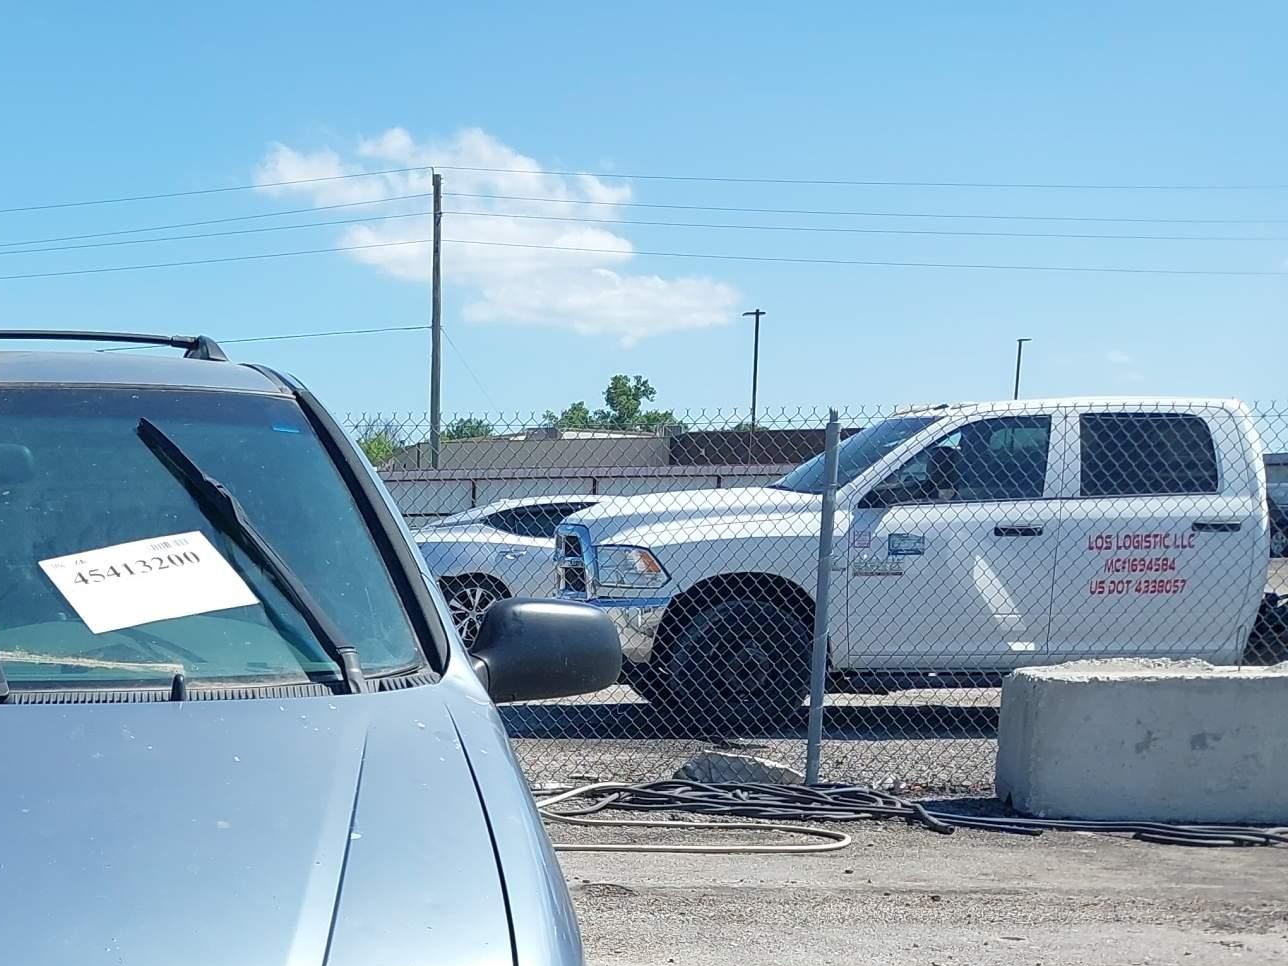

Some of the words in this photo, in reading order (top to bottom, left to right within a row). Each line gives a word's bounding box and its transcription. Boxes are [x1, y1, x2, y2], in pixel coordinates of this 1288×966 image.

[1088, 534, 1113, 551] LOS
[1116, 533, 1170, 550] LOGISTIC
[1174, 533, 1195, 549] LLC
[73, 551, 200, 585] 45413200
[1089, 580, 1105, 595] US
[1108, 580, 1131, 594] DOT
